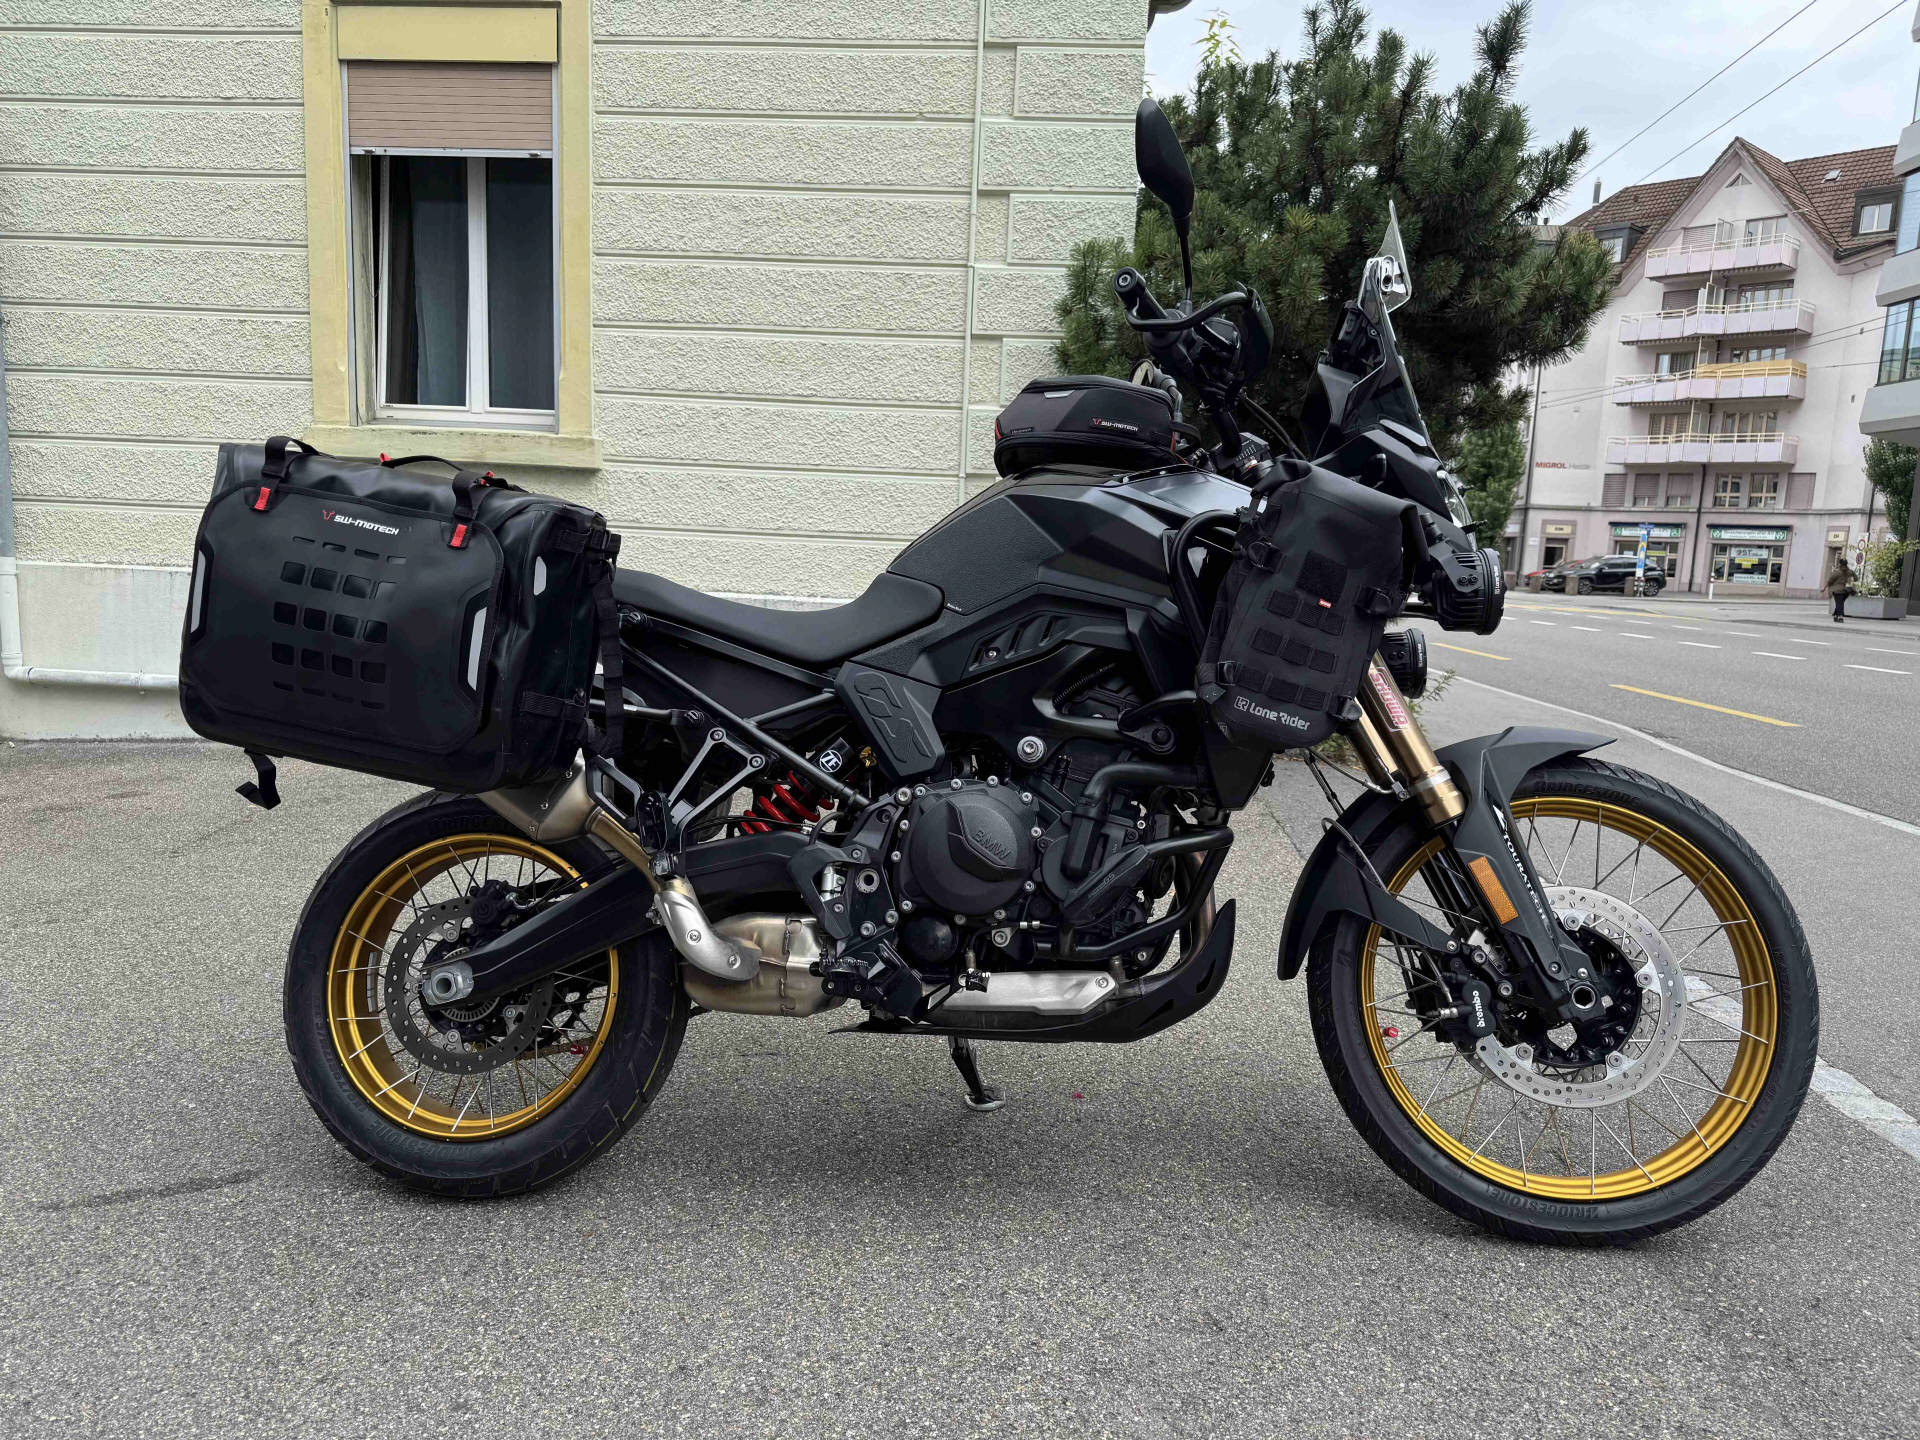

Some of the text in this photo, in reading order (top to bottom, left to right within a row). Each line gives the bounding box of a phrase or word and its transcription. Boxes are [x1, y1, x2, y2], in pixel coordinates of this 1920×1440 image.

[1101, 420, 1139, 432] SW-MOTECH
[333, 513, 400, 537] SW-MOTECH
[1369, 672, 1409, 726] SHOWA
[1249, 702, 1278, 721] Lone
[1279, 711, 1311, 731] Rider
[820, 750, 842, 772] ZF
[972, 829, 1012, 861] BMW
[1503, 832, 1547, 921] TOURATECH
[1472, 990, 1486, 1028] brembo
